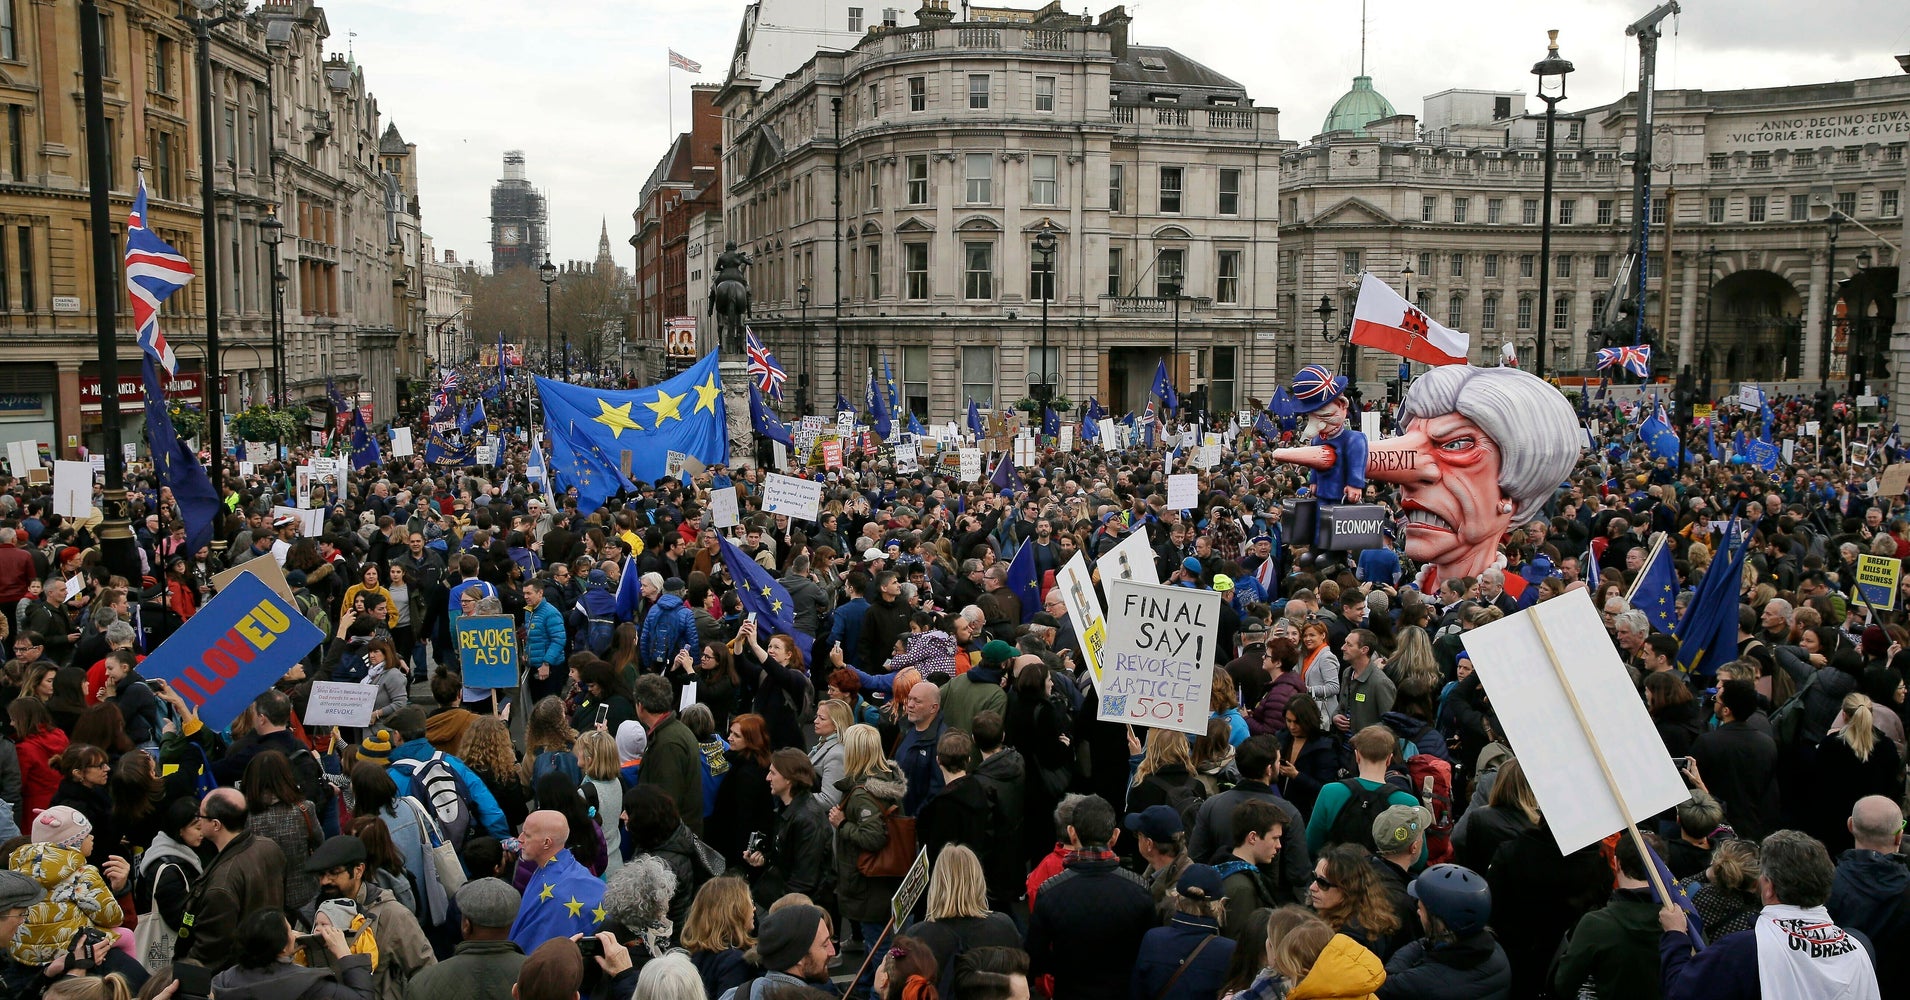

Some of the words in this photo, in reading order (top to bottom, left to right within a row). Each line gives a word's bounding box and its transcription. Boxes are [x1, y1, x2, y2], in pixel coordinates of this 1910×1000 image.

[1760, 119, 1803, 130] ANNO
[1810, 114, 1864, 128] DECIMO
[839, 412, 852, 424] 2ND
[1369, 450, 1418, 472] BREXIT
[1335, 520, 1383, 534] ECONOMY
[1863, 565, 1881, 573] KILLS
[1867, 557, 1890, 566] BREXIT
[1860, 574, 1893, 584] BUSINESS
[1124, 595, 1206, 627] FINAL
[460, 628, 514, 649] REVOKE
[1136, 623, 1204, 669] SAY!
[475, 647, 510, 665] A50
[1116, 653, 1194, 682] REVOKE
[1106, 676, 1200, 702] ARTICLE
[1131, 698, 1184, 723] 50!
